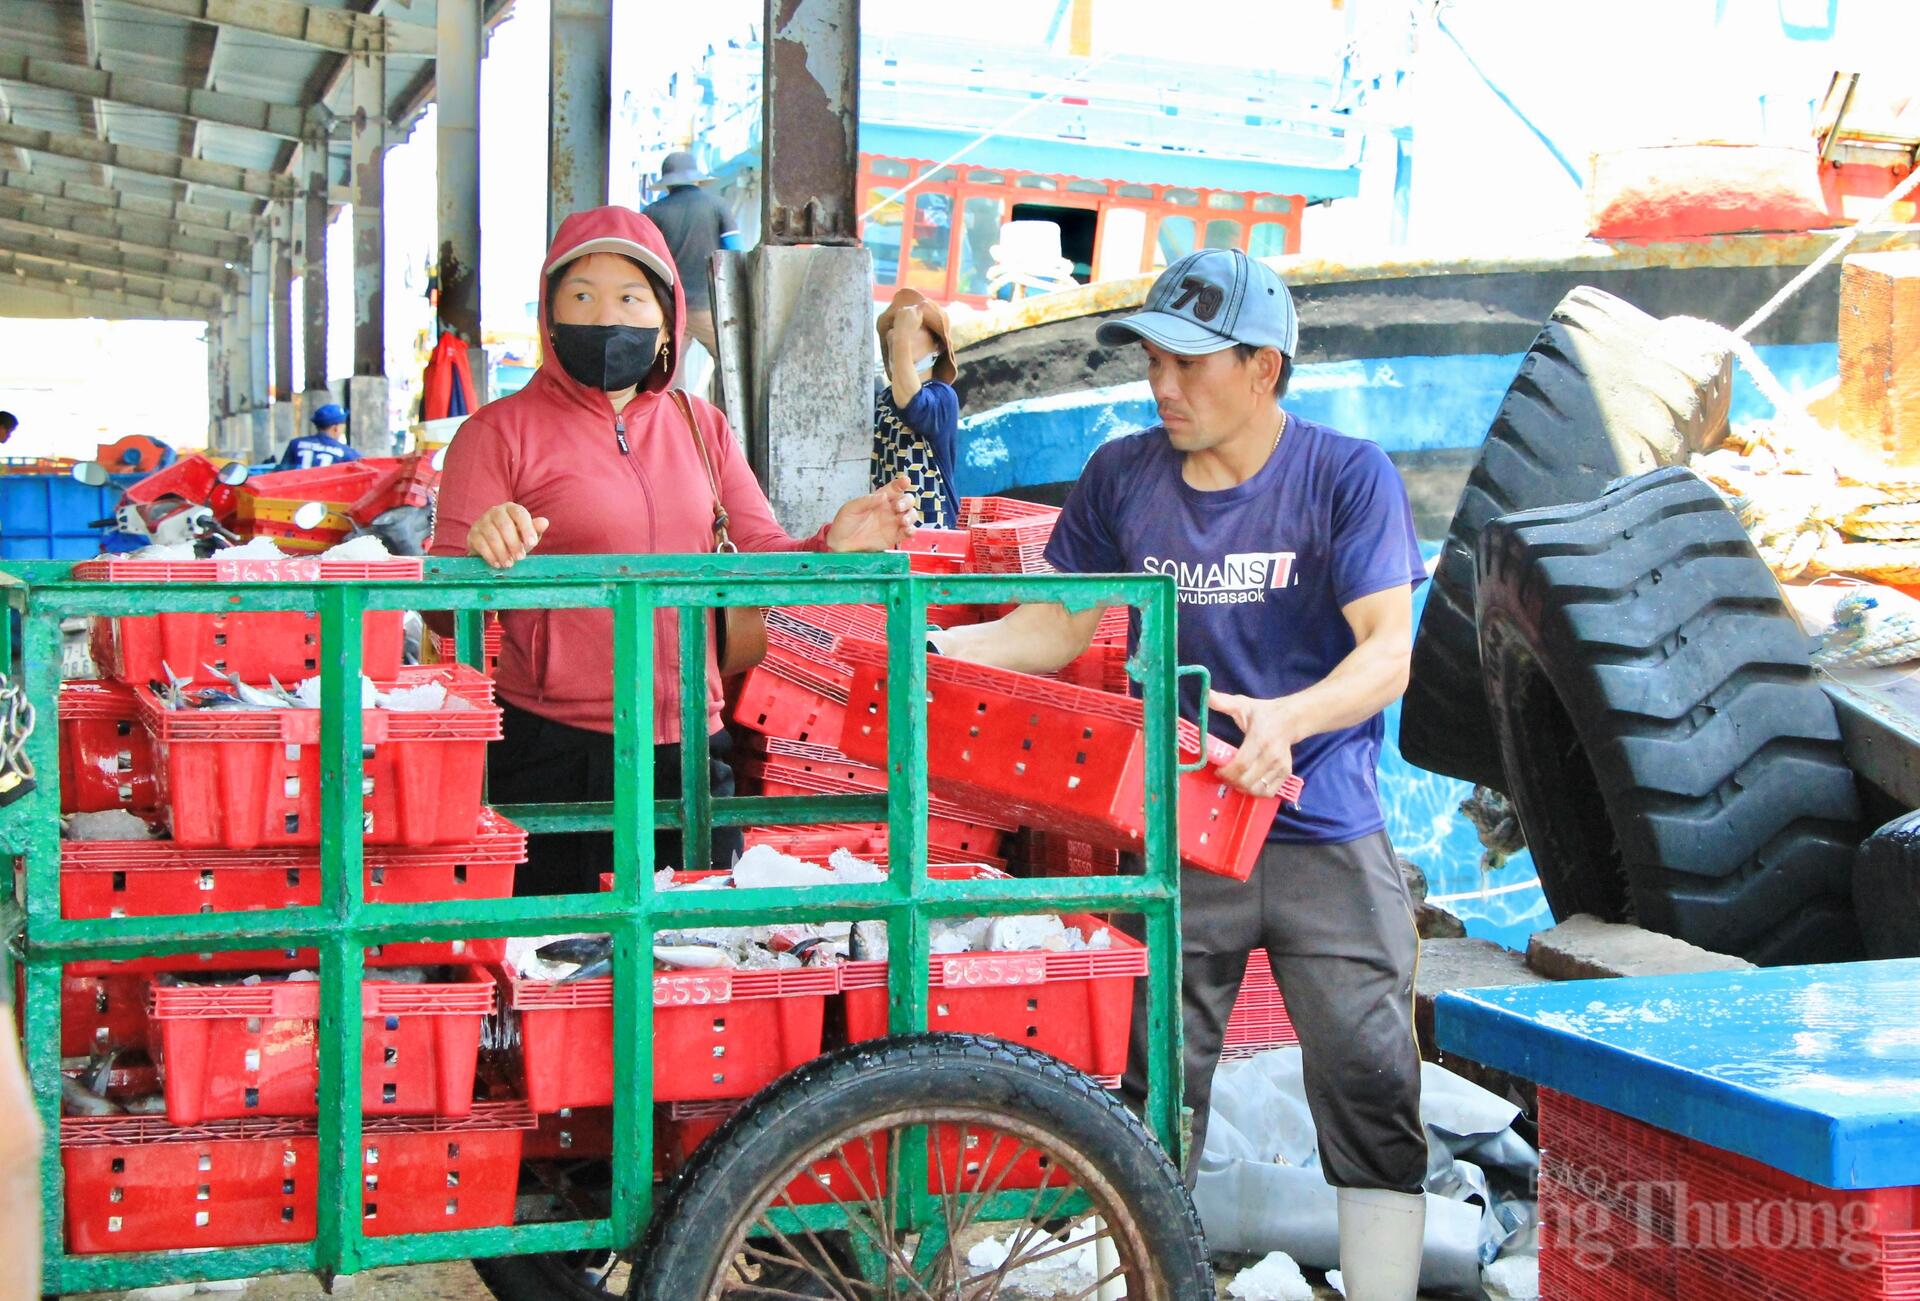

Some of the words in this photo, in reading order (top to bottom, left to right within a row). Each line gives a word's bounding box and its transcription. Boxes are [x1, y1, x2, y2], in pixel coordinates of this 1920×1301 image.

[1169, 275, 1224, 322] 79
[1177, 590, 1265, 605] vubnasaok
[943, 959, 1043, 985] 96559
